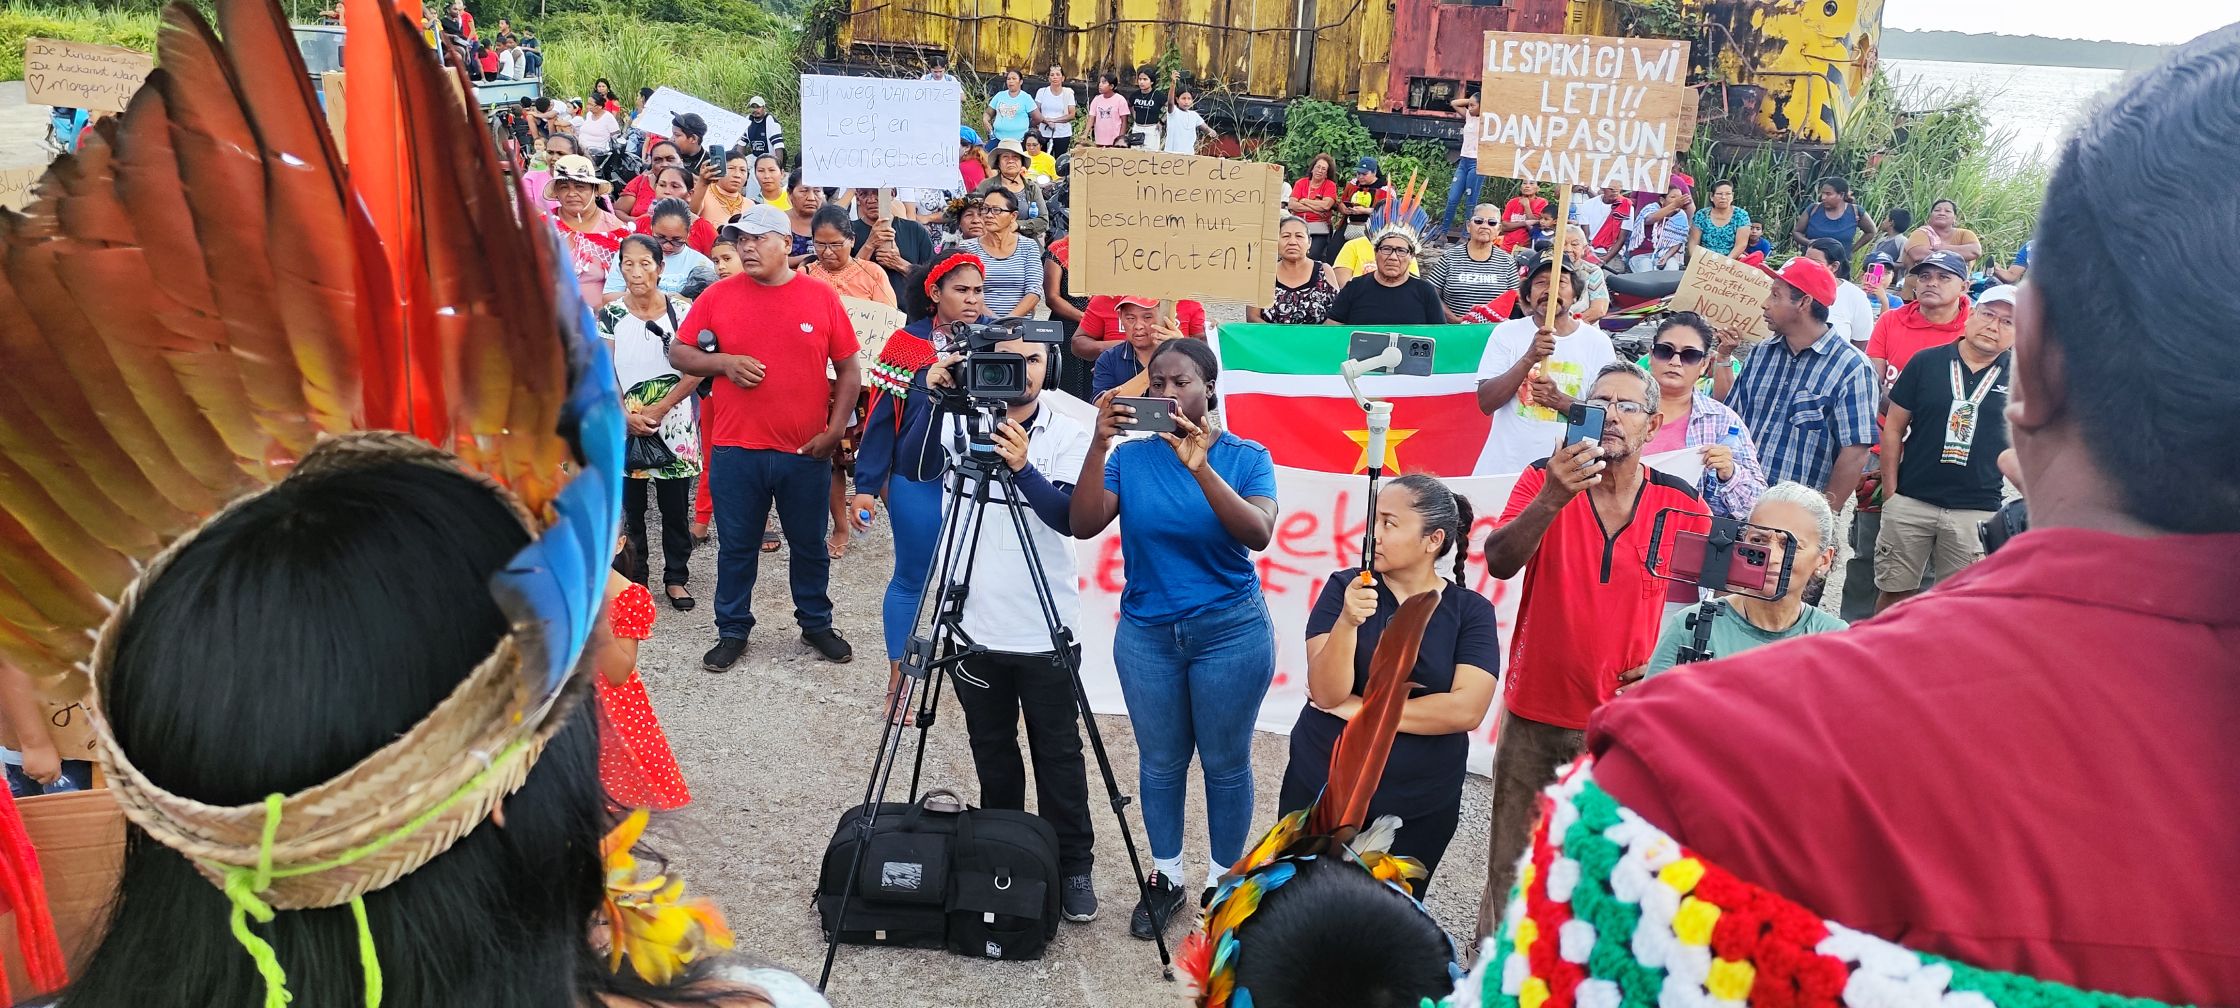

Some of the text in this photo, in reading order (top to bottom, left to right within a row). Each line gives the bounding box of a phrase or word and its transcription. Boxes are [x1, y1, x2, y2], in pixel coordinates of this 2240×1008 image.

[32, 45, 56, 55] De
[30, 62, 50, 70] De
[837, 85, 875, 110] weg
[915, 86, 958, 101] onze
[1133, 98, 1155, 107] POLO
[826, 112, 909, 142] Leef en
[1208, 163, 1244, 181] de
[1195, 212, 1237, 232] hun
